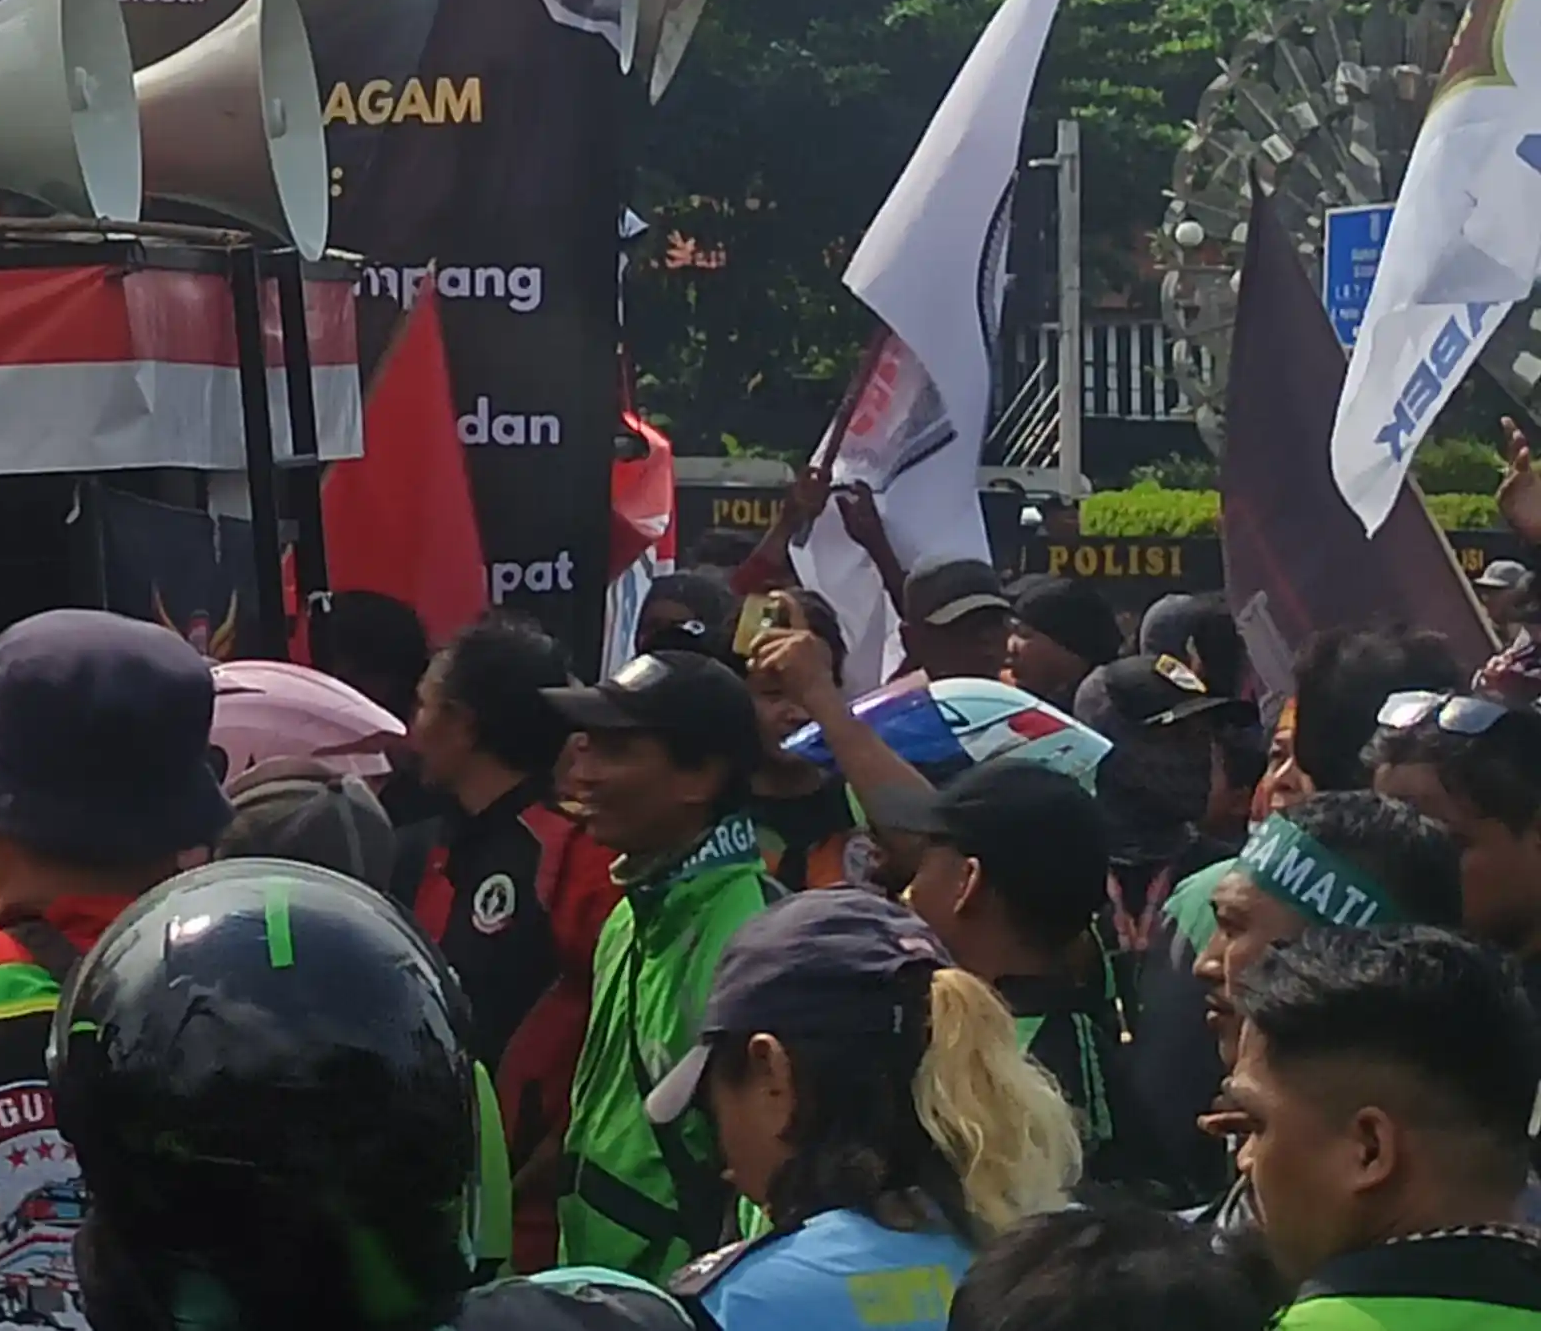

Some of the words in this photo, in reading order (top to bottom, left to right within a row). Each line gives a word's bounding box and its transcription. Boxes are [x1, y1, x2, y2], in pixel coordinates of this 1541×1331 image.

[321, 76, 483, 125] AGAM
[456, 395, 561, 446] dan
[713, 498, 785, 526] POLI
[482, 549, 574, 605] pat
[1048, 544, 1183, 578] POLISI
[1272, 845, 1379, 928] MATI
